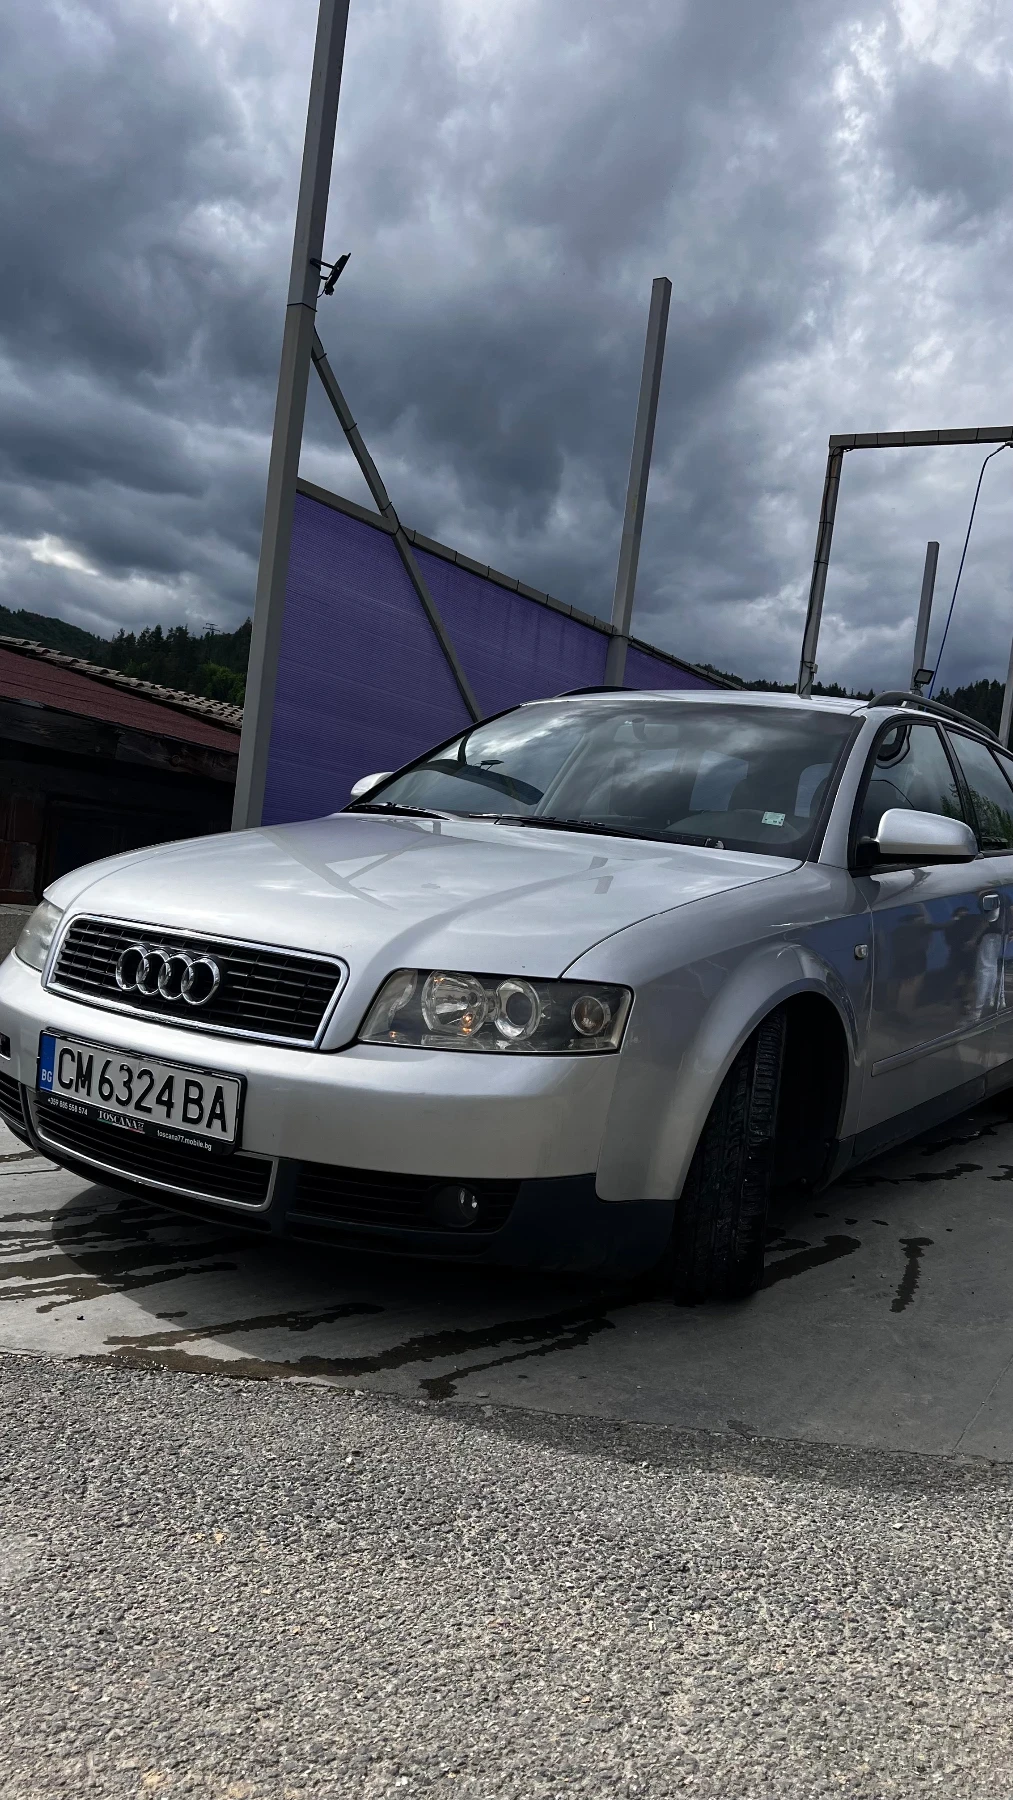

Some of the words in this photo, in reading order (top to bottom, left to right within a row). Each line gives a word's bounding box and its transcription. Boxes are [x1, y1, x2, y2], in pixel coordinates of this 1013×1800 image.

[41, 1069, 53, 1083] BG
[78, 1106, 88, 1116] 574
[157, 1130, 212, 1151] toscana77.mobile.bg
